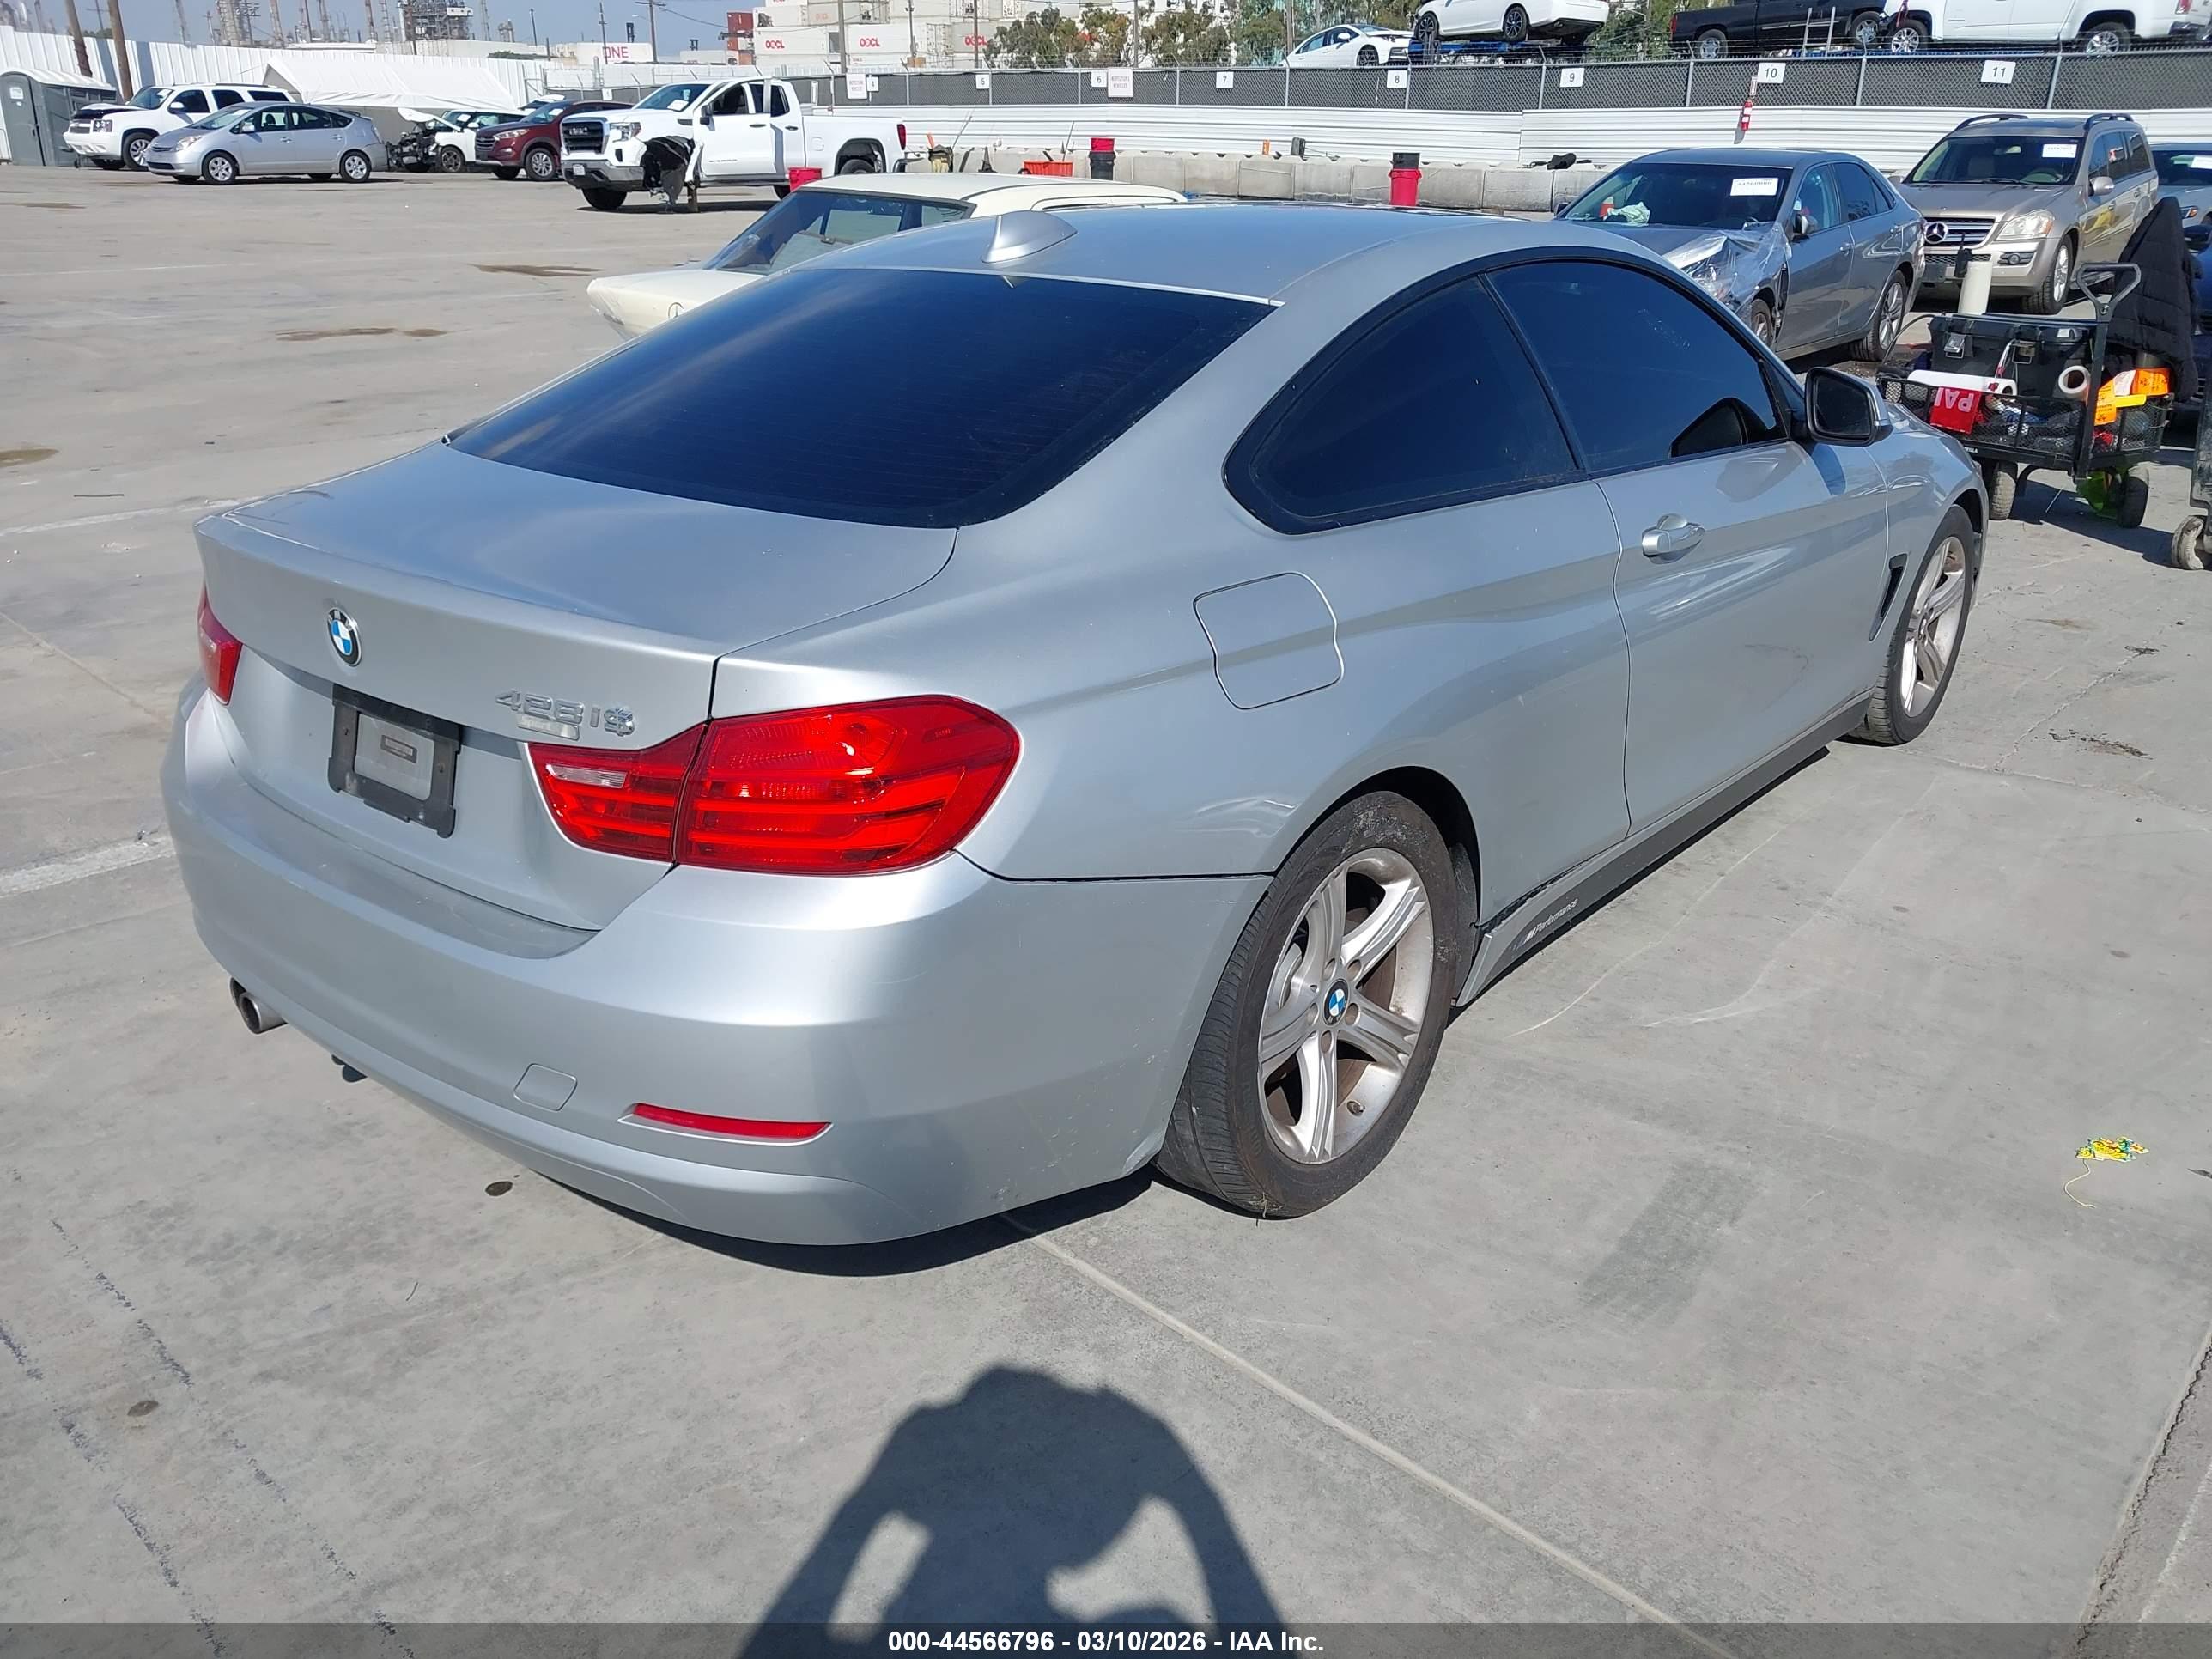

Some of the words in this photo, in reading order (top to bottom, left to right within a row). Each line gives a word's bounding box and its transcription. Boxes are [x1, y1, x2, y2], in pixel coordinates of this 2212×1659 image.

[765, 40, 785, 49] OOCL
[860, 38, 880, 47] OOCL
[603, 46, 629, 58] ONE
[1765, 68, 1778, 78] 10
[1992, 67, 2006, 78] 11
[1097, 76, 1102, 84] 6
[1395, 76, 1400, 84] 8
[1569, 73, 1575, 82] 9
[1536, 898, 1579, 933] Performance
